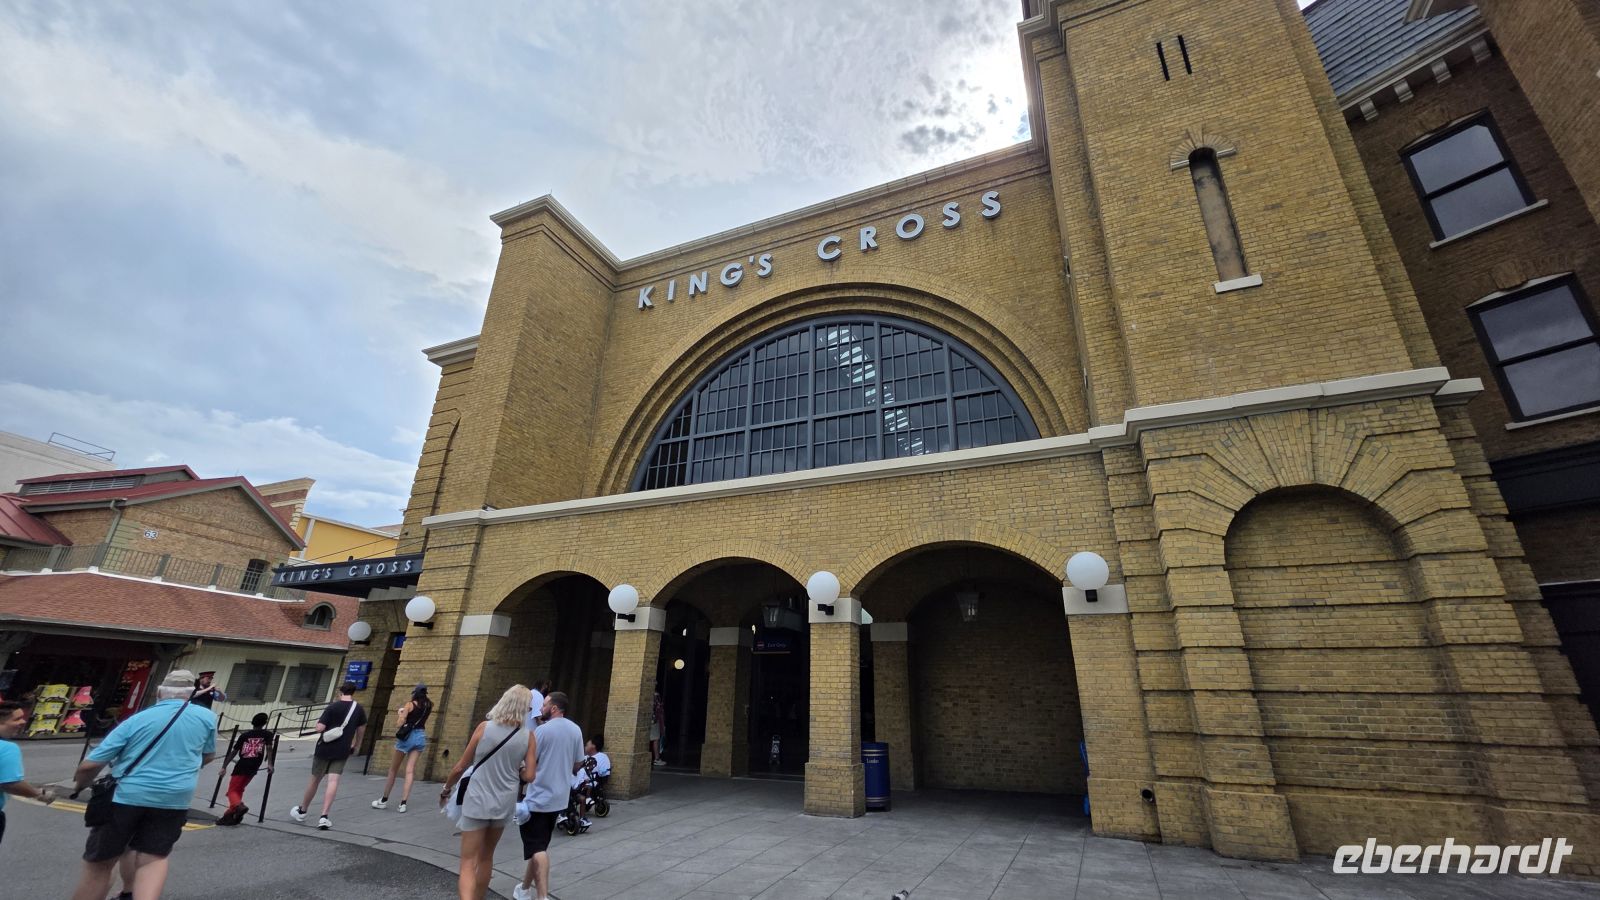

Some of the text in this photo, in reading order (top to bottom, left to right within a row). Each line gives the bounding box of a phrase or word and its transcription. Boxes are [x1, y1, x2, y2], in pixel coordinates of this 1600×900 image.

[638, 191, 1001, 310] KING'S CROSS
[278, 560, 413, 583] KING'S CROSS
